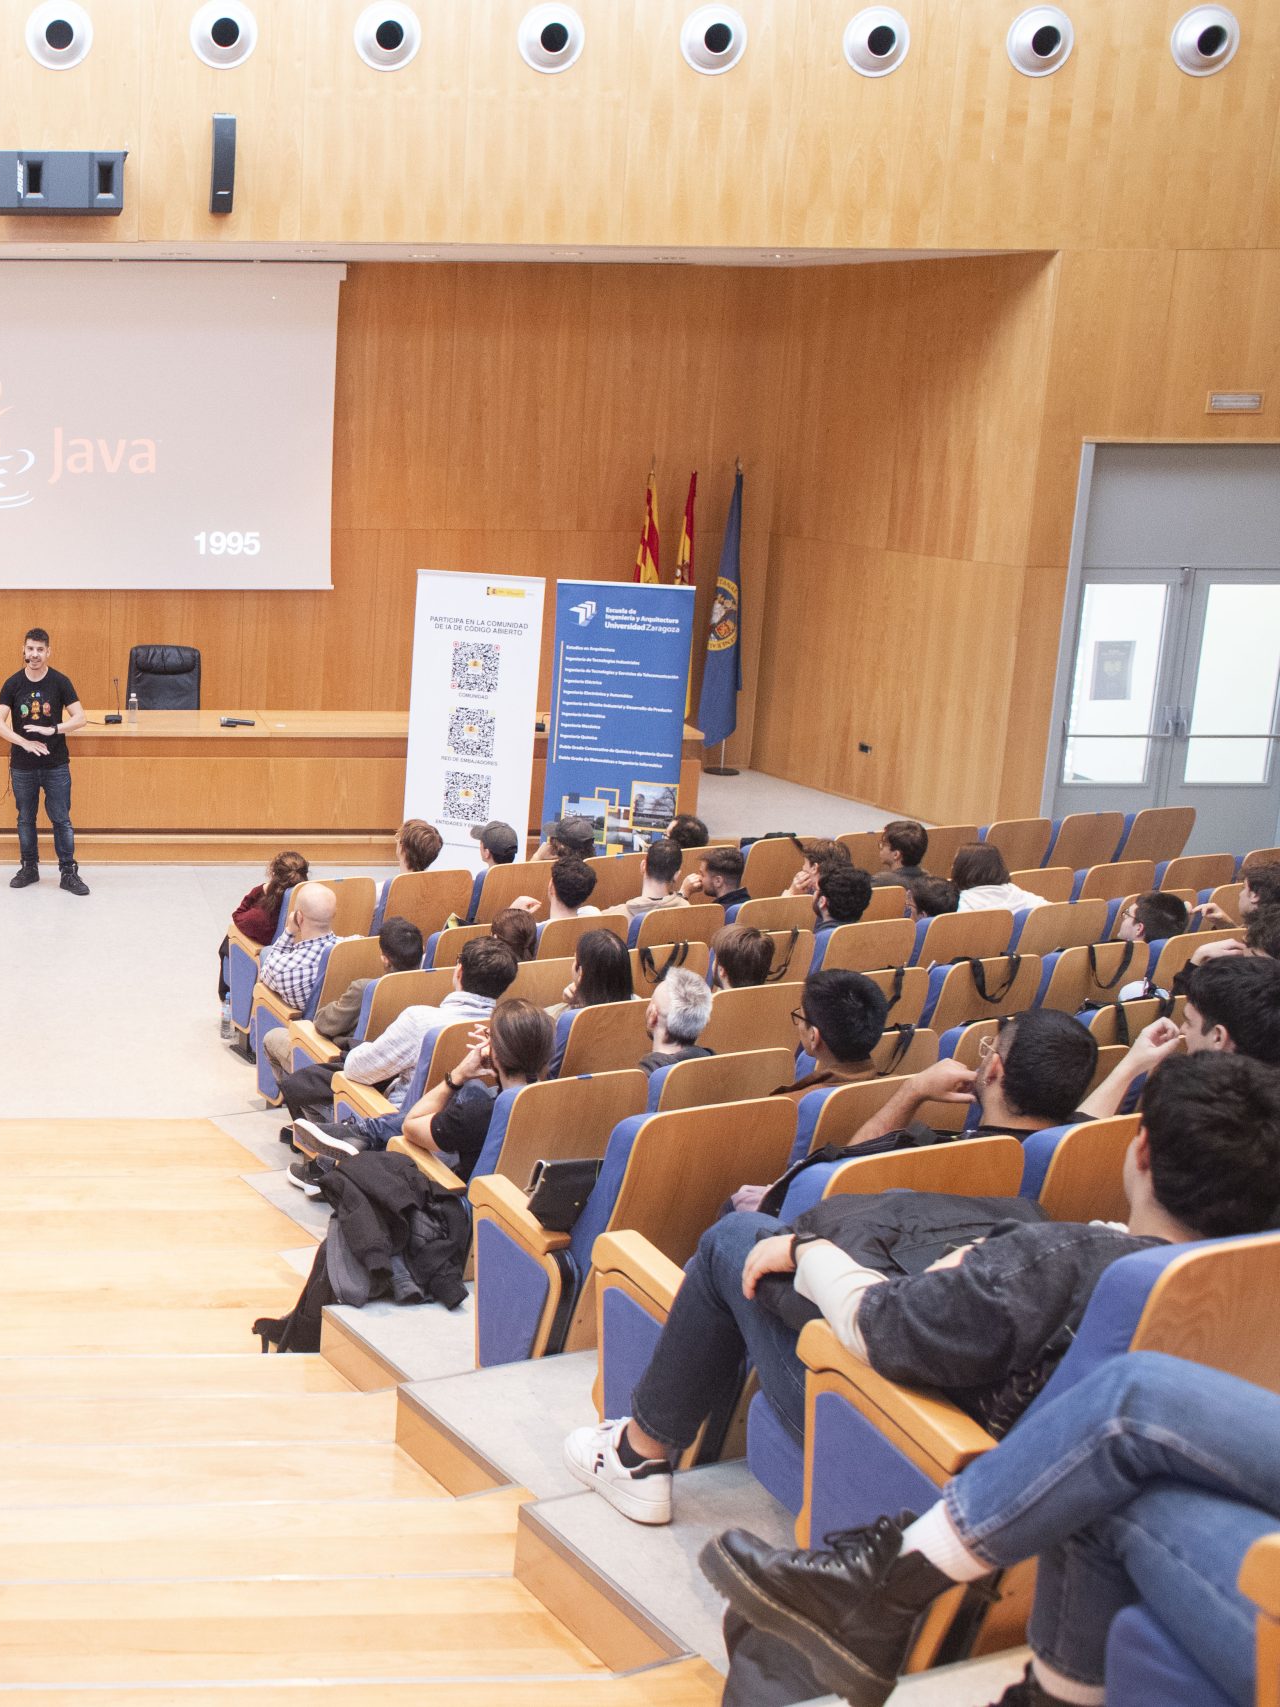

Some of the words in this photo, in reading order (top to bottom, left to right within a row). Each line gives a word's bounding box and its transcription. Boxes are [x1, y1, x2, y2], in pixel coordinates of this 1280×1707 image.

[48, 427, 156, 484] Java
[194, 531, 261, 556] 1995
[605, 607, 628, 615] Escuela
[429, 616, 464, 625] PARTICIPA
[476, 619, 485, 627] LA
[486, 620, 529, 630] COMUNIDAD
[605, 614, 635, 622] Ingeniería
[641, 615, 679, 624] Arquitectura
[493, 628, 523, 636] ABIERTO
